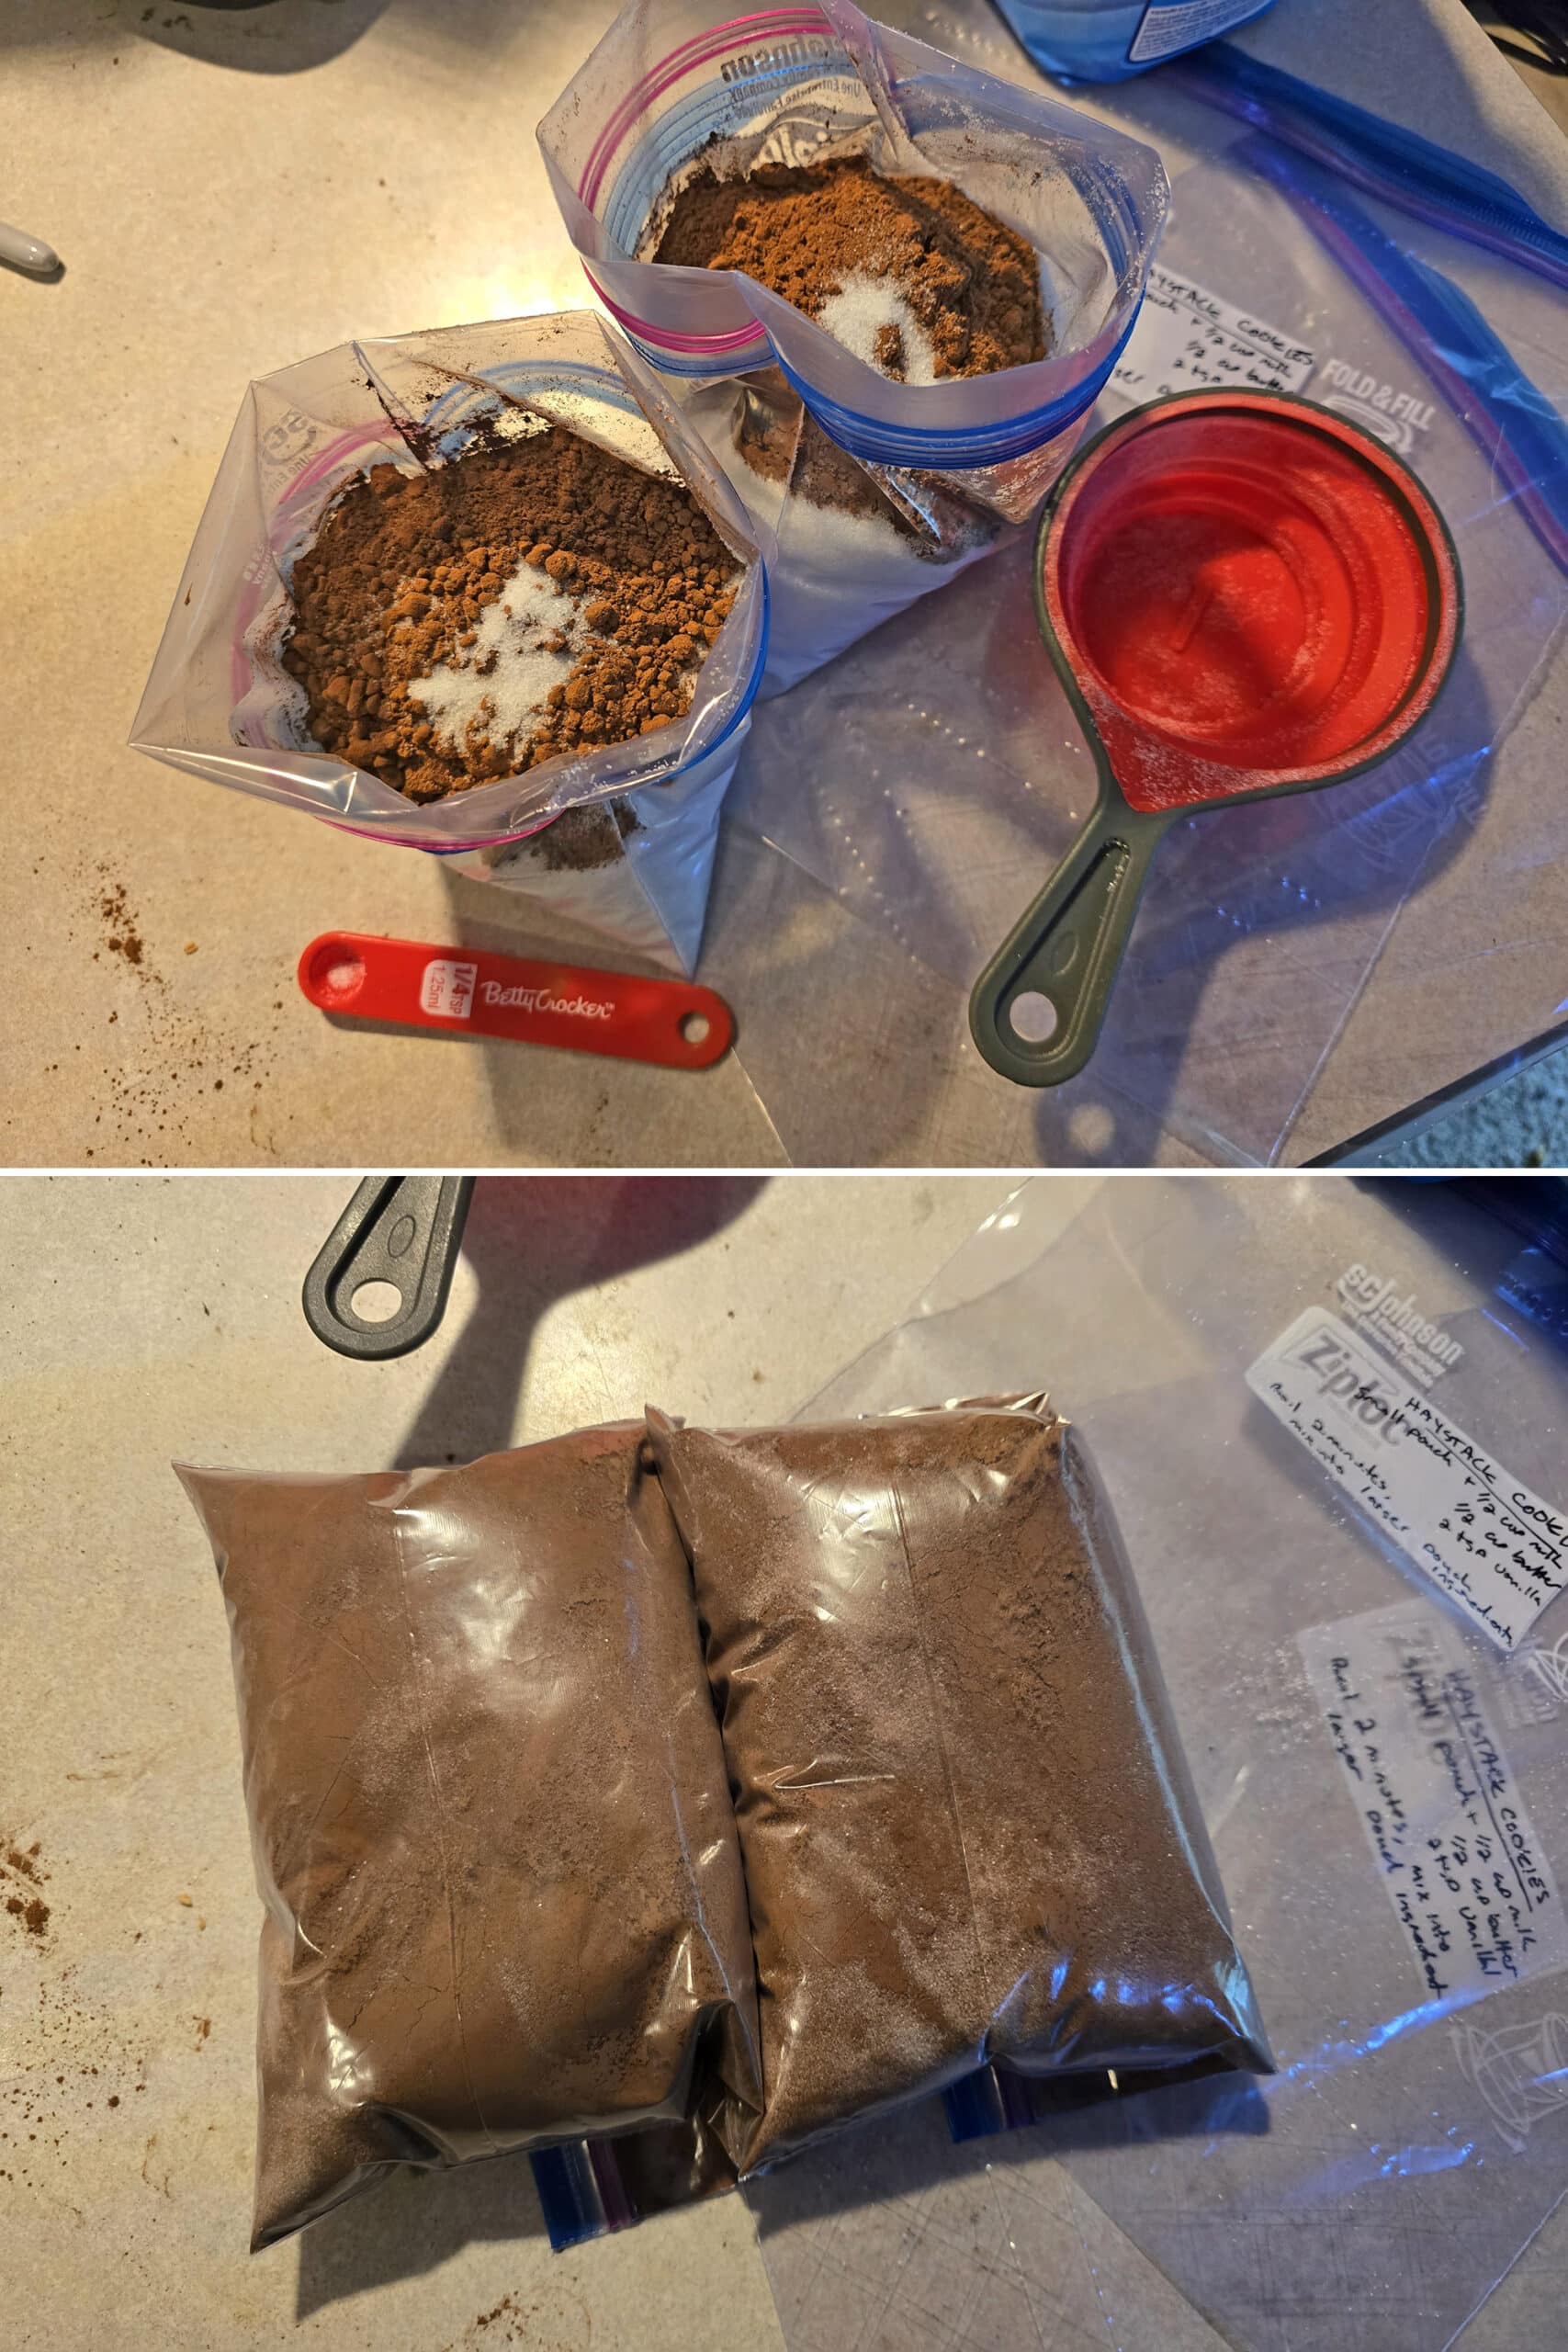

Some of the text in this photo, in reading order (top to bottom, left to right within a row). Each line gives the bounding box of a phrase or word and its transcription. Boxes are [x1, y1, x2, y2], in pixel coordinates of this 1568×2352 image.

[1320, 358, 1377, 400] FOLD
[1389, 392, 1436, 431] FILL
[1404, 1396, 1497, 1485] HAYSTACK
[1438, 1518, 1451, 1532] 2
[1352, 1717, 1377, 1736] 2
[1500, 1806, 1551, 1905] COOKIES
